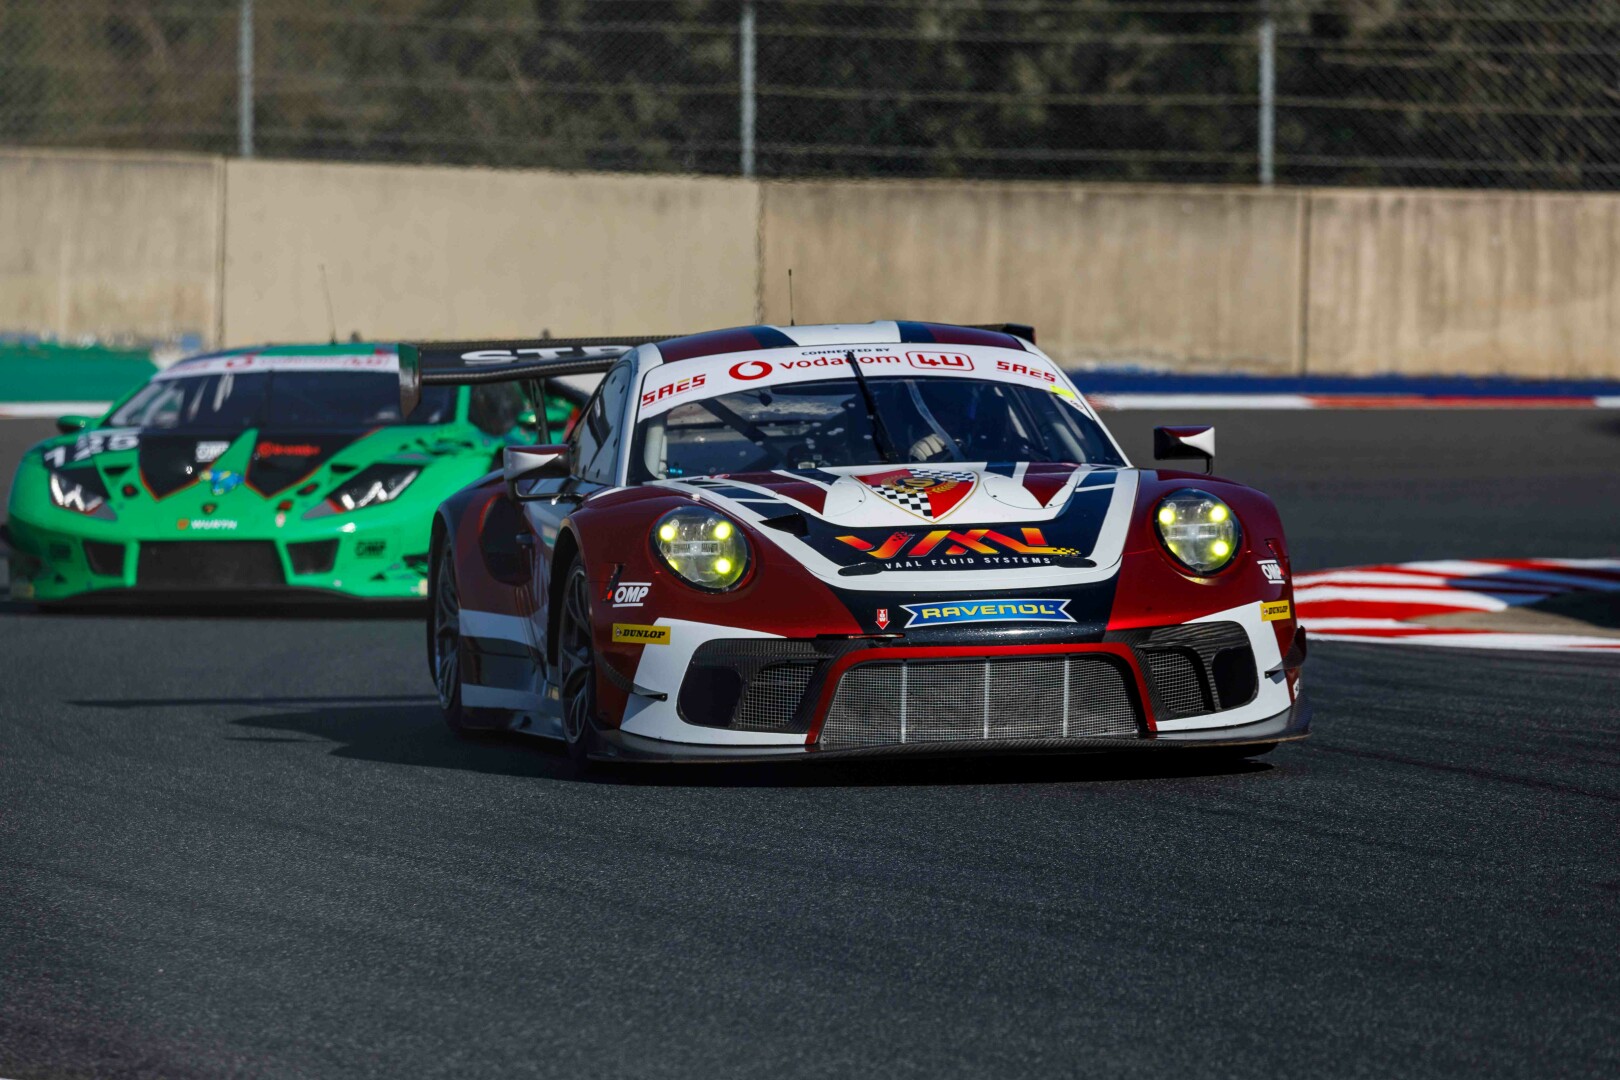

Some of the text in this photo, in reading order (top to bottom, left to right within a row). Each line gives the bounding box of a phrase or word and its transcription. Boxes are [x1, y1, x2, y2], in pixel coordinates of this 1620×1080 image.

[780, 356, 901, 370] vodacom
[917, 354, 964, 367] 4U
[996, 361, 1056, 382] SAES
[642, 374, 706, 407] SAES
[885, 556, 1051, 569] VAAL FLUID SYSTEMS
[614, 586, 649, 603] OMP
[921, 604, 1056, 619] RAVENOL
[1268, 605, 1288, 615] DUNLOP
[622, 628, 666, 639] DUNLOP
